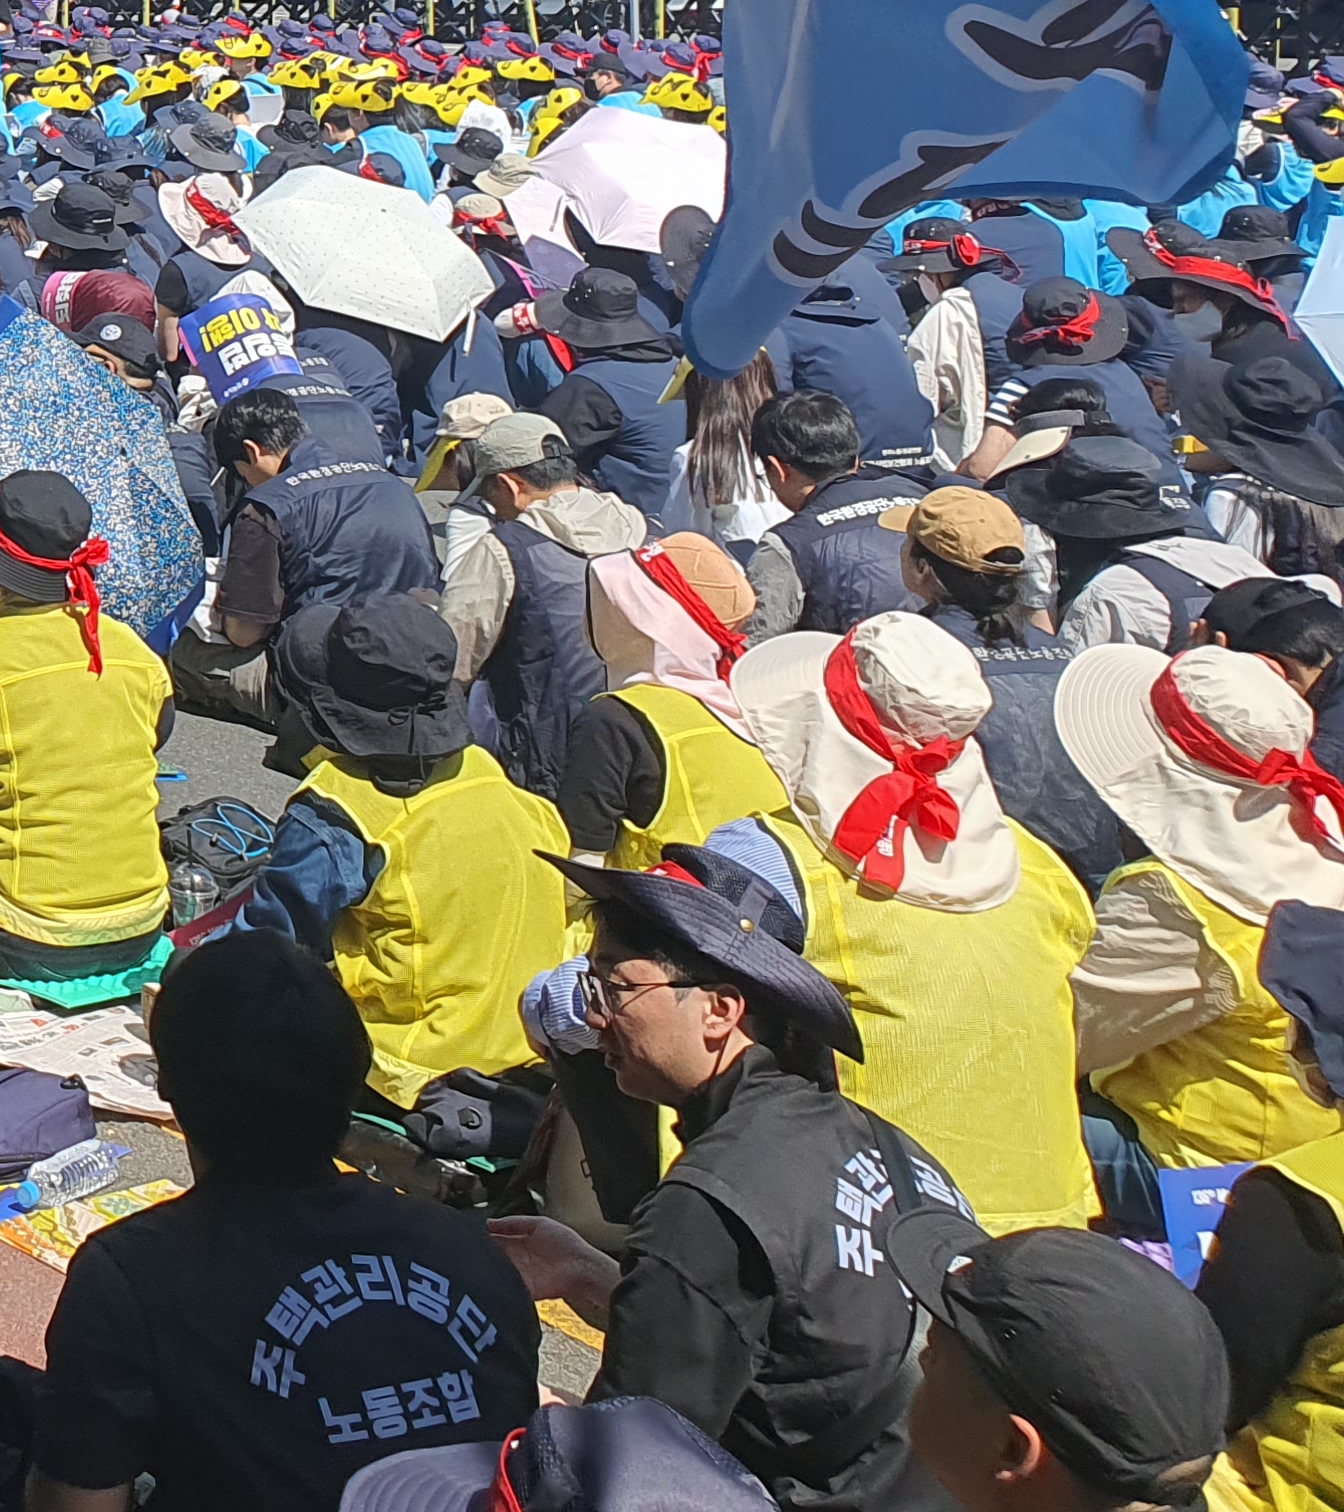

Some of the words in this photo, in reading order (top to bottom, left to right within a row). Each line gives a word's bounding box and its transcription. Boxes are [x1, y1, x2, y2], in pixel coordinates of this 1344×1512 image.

[198, 307, 261, 353] 이행!
[249, 1253, 498, 1399] 주택관리공단
[317, 1368, 482, 1445] 노동조합
